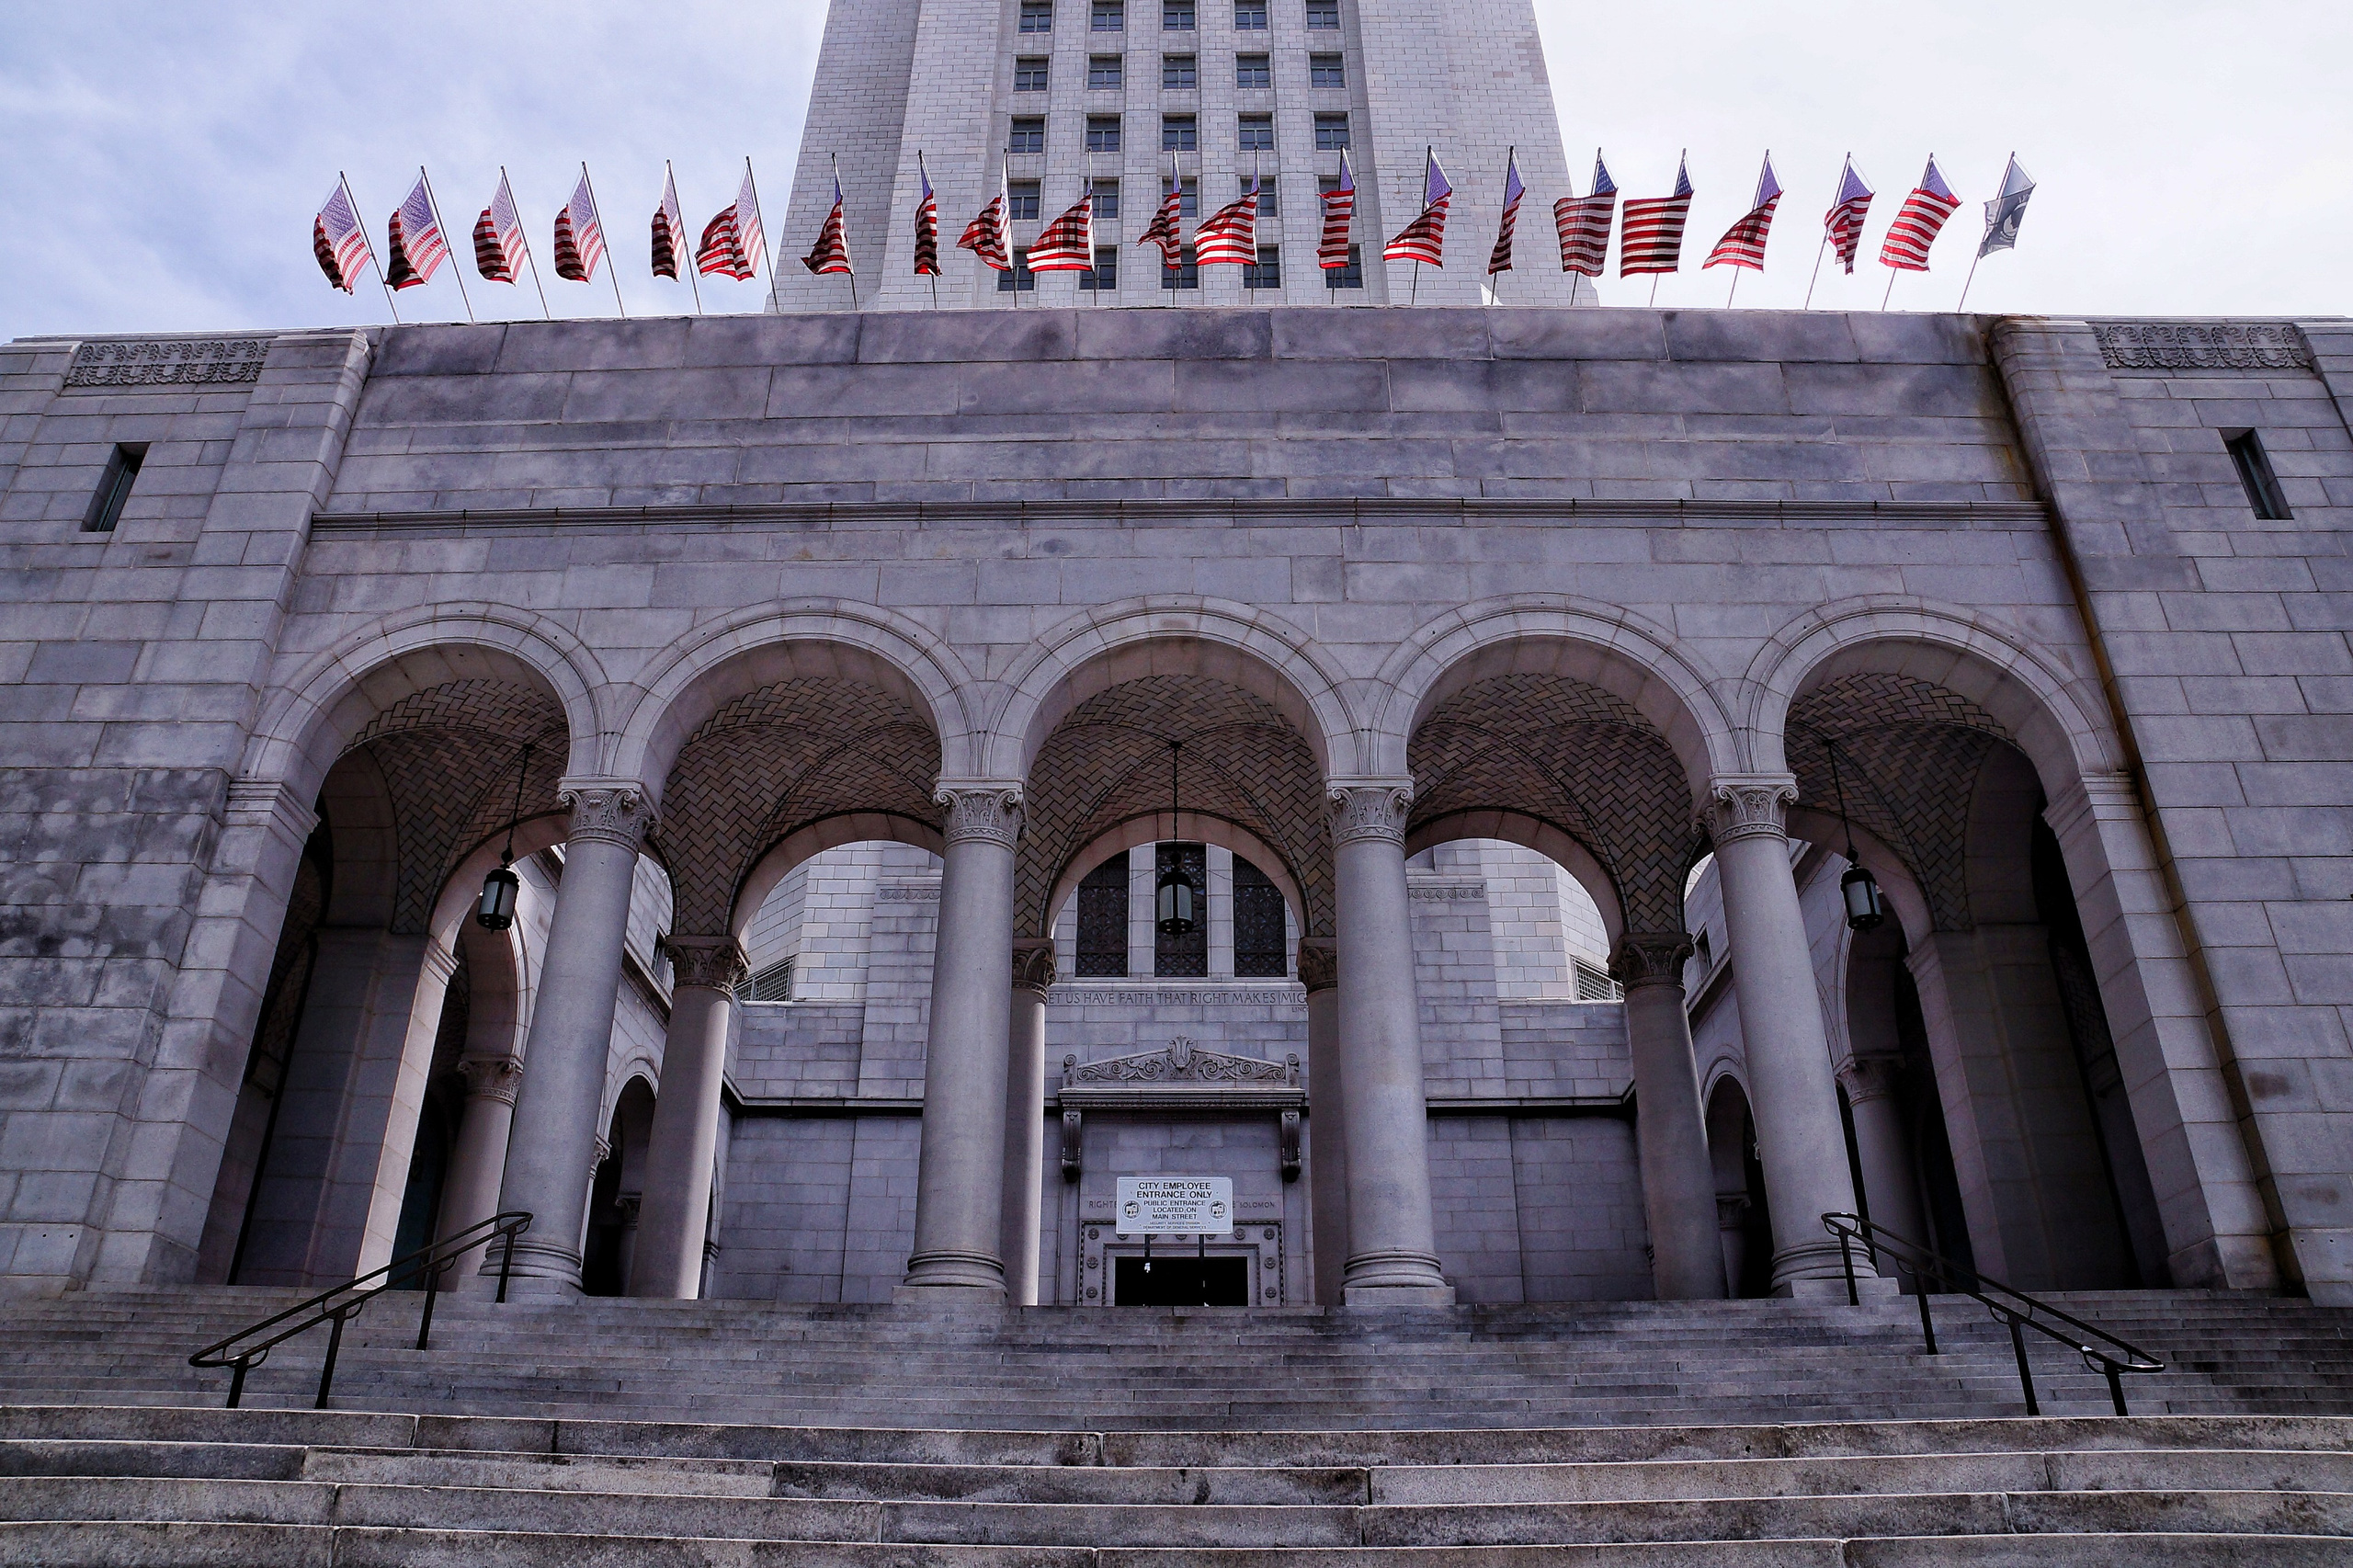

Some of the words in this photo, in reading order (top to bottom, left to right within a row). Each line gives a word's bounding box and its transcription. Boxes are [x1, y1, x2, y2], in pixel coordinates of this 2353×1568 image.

[1048, 993, 1062, 1004] ET
[1066, 993, 1080, 1004] US
[1085, 993, 1114, 1004] HAVE
[1120, 993, 1154, 1004] FAITH
[1157, 993, 1187, 1004] THAT
[1191, 993, 1228, 1004] RIGHT
[1233, 993, 1276, 1004] MAKES
[1281, 993, 1306, 1004] MIG
